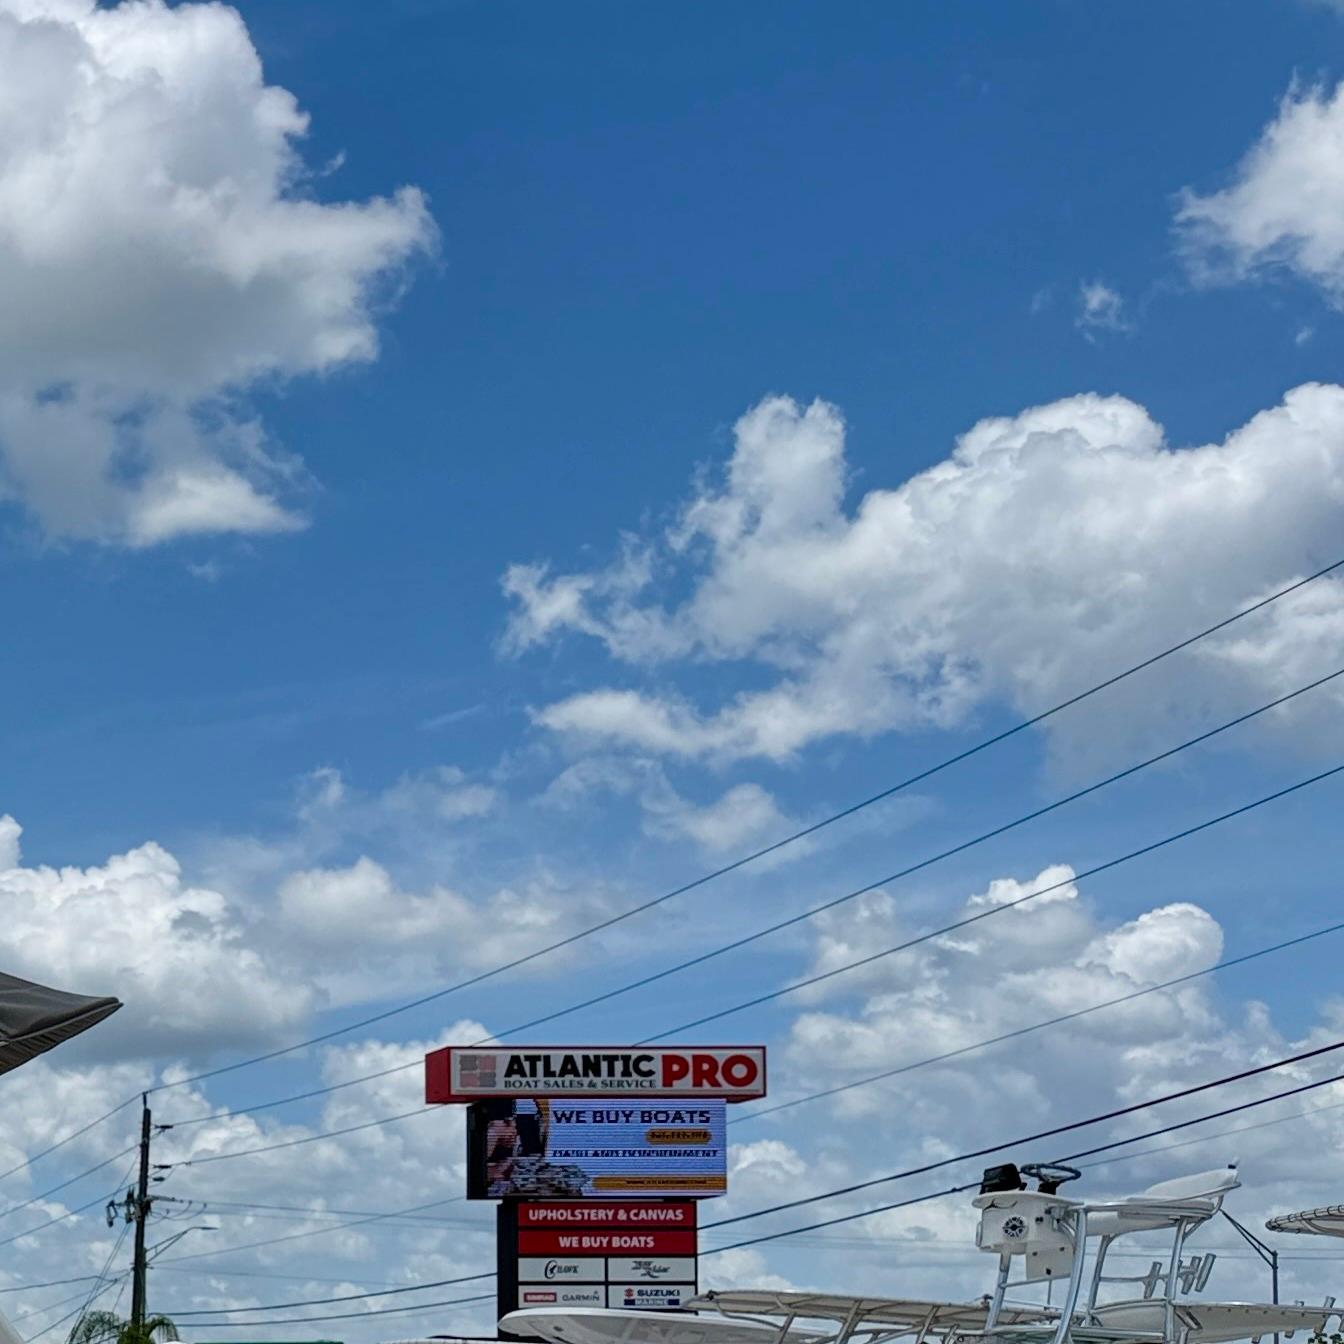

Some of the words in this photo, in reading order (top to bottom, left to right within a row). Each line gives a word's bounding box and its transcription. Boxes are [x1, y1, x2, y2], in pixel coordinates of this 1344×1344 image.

[504, 1053, 656, 1078] ATLANTIC
[661, 1053, 759, 1088] PRO
[504, 1079, 541, 1089] BOAT
[543, 1079, 584, 1089] SALES
[587, 1079, 598, 1089] &
[600, 1079, 657, 1089] SERVICE
[553, 1110, 587, 1124] WE
[592, 1110, 634, 1124] BUY
[640, 1110, 711, 1124] BOATS
[528, 1209, 614, 1221] UPHOLSTERY
[617, 1209, 628, 1221] &
[629, 1209, 684, 1221] CANVAS
[558, 1236, 579, 1248] WE
[581, 1236, 609, 1248] BUY
[612, 1236, 655, 1248] BOATS
[562, 1293, 601, 1302] GARMIN
[637, 1289, 681, 1297] SUZUKI
